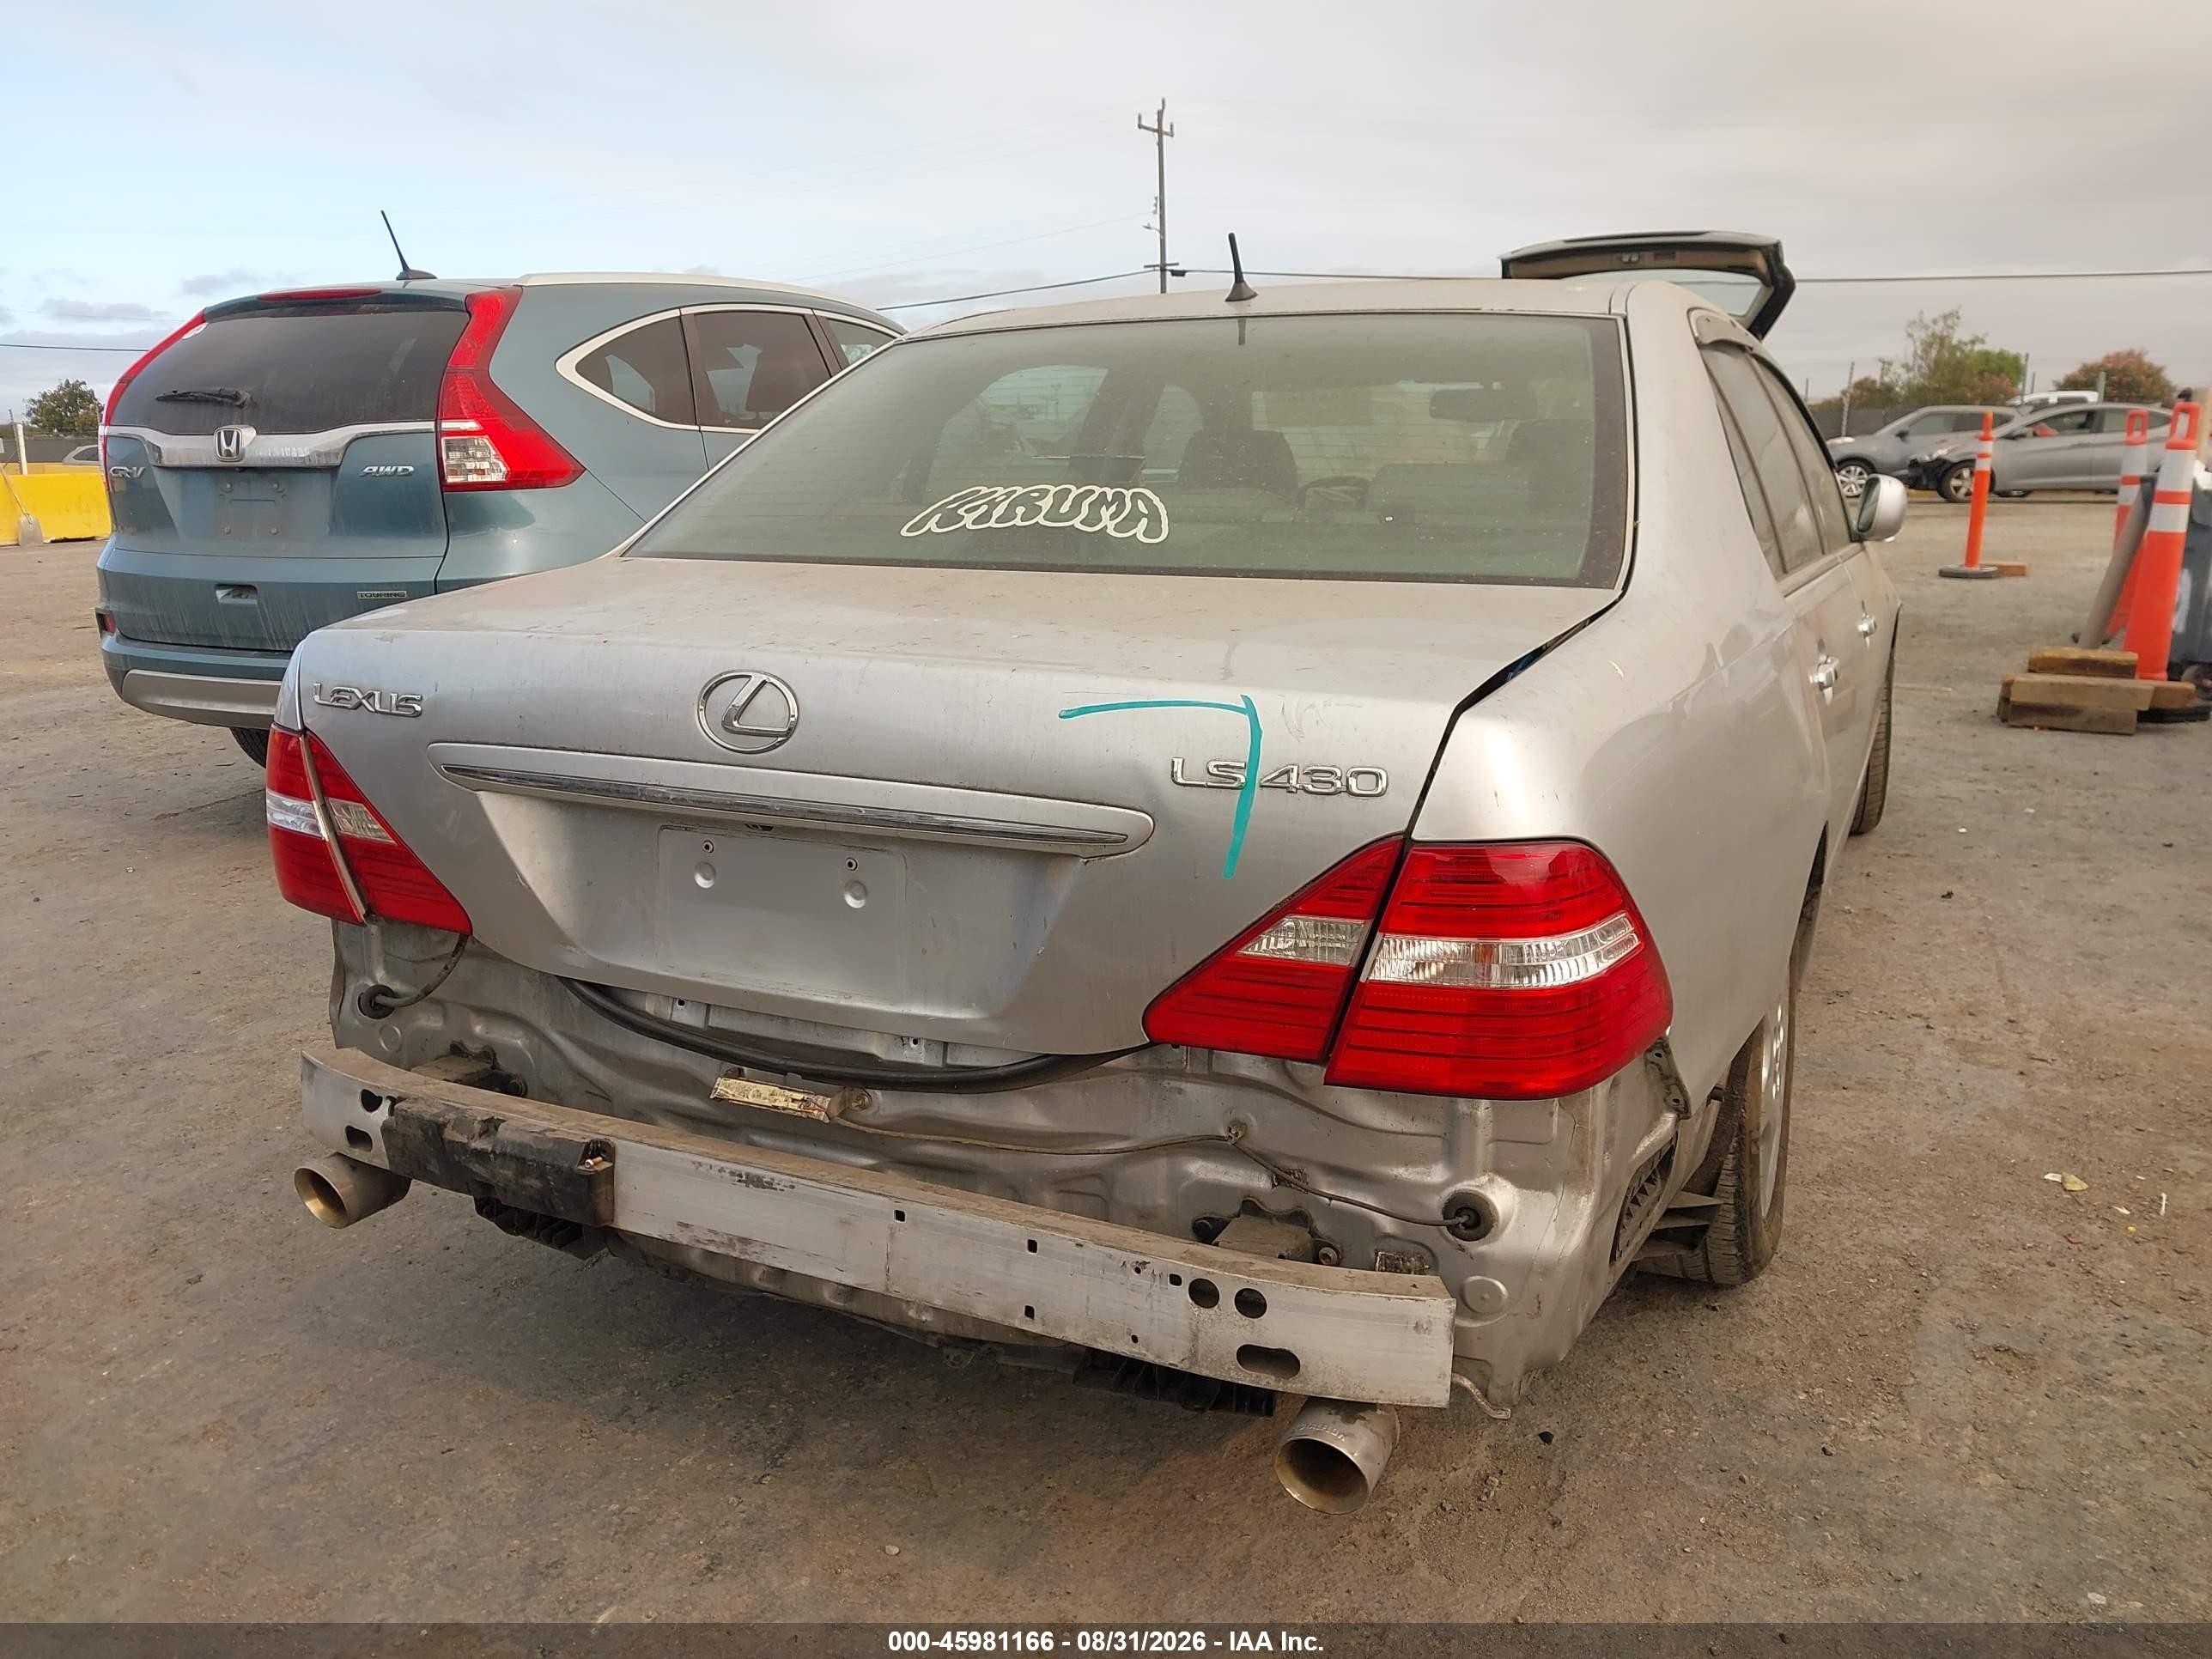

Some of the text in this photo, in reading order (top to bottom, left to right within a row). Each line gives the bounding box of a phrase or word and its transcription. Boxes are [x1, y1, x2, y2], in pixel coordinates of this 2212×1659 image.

[359, 465, 415, 477] AWD
[313, 682, 422, 718] LEXUS
[1170, 757, 1389, 797] LS 430
